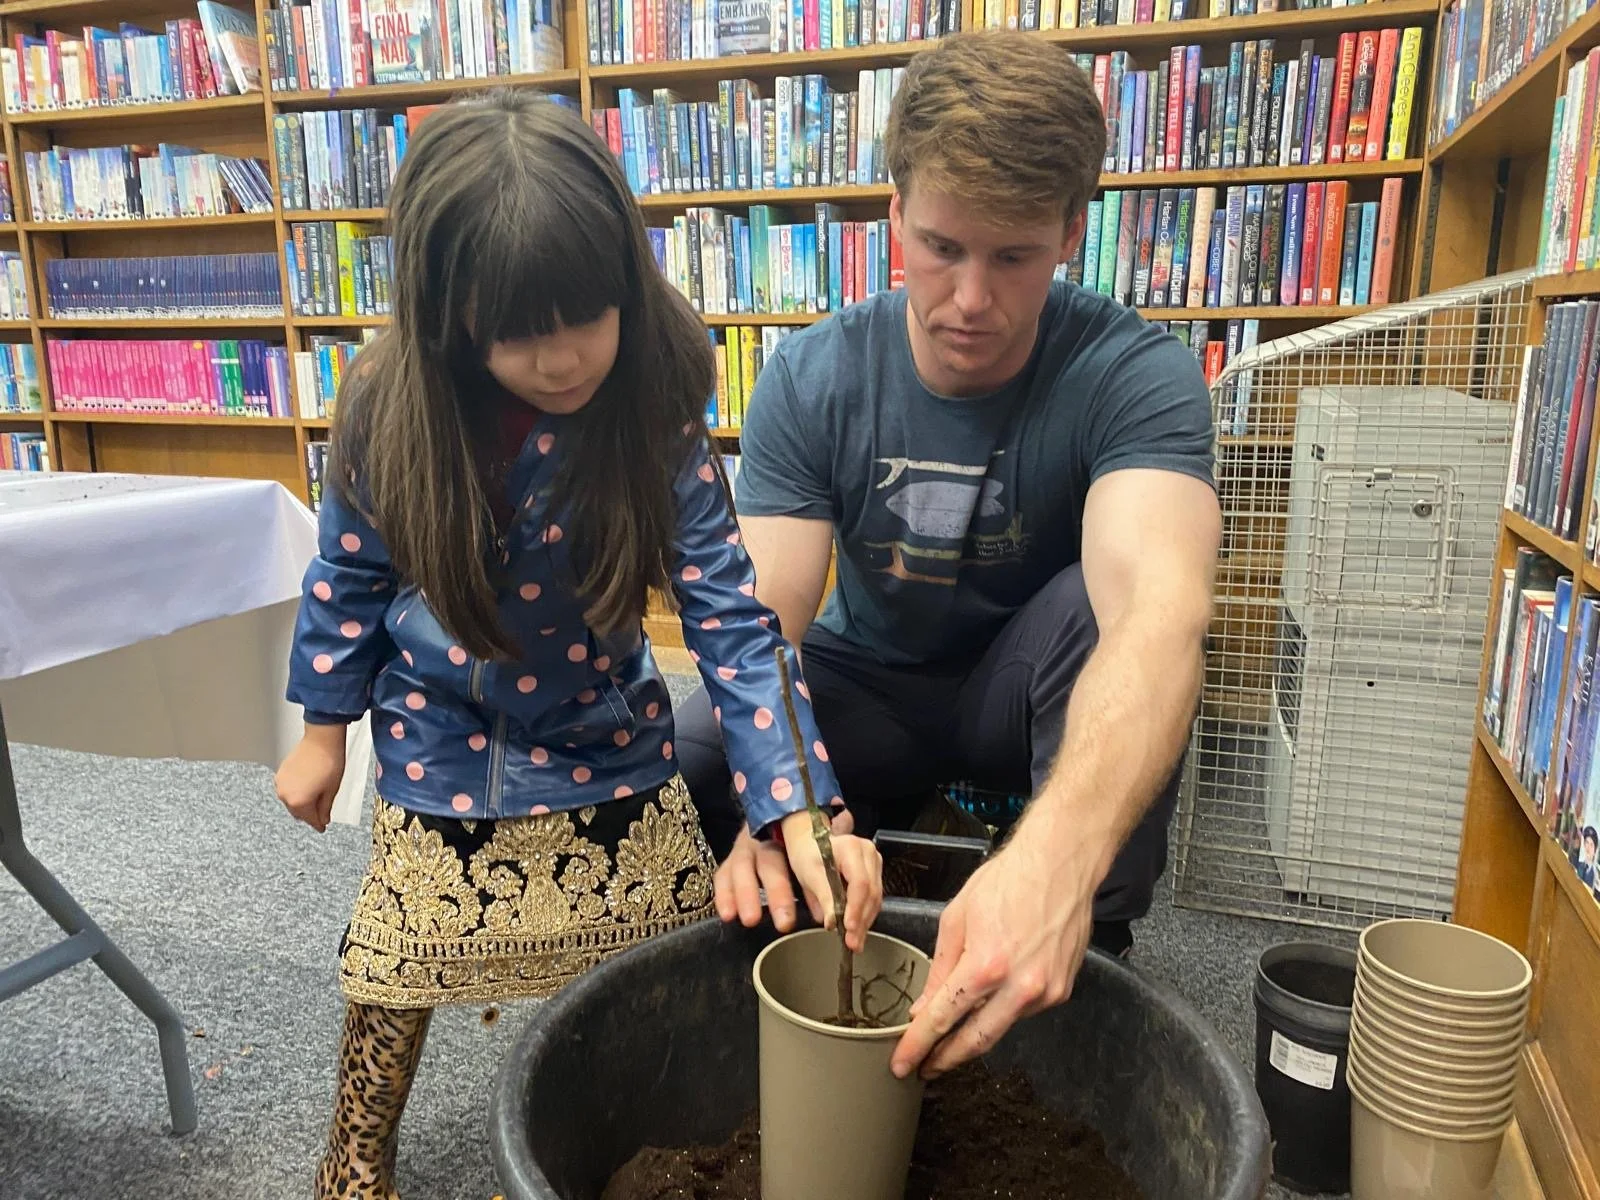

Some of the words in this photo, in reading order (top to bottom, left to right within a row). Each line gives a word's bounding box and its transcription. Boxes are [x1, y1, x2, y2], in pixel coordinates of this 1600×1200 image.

[375, 12, 413, 39] FINAL
[380, 39, 412, 65] NAIL
[1358, 36, 1373, 76] Cleeves
[1406, 33, 1419, 61] Ann
[1172, 51, 1182, 73] THE
[1171, 75, 1181, 97] LIES
[1339, 72, 1350, 99] CLARY
[1396, 62, 1416, 117] Cleeves
[1169, 107, 1179, 130] TELL
[1270, 96, 1281, 128] FOLLOW
[1268, 129, 1278, 140] ME
[1142, 198, 1155, 231] Harlan
[1161, 201, 1172, 230] Harlan
[1179, 199, 1190, 229] Harlan
[1227, 195, 1241, 237] HANGMAN
[1291, 194, 1299, 214] From
[1088, 205, 1099, 247] HARLAN
[1250, 212, 1260, 252] MARTINA
[1270, 211, 1281, 252] MARTINA
[1288, 231, 1296, 247] Until
[1175, 231, 1187, 259] Coben
[1085, 249, 1097, 285] COBEN
[1211, 247, 1221, 275] COBEN
[1248, 254, 1258, 279] COLE
[1267, 254, 1277, 278] COLE
[1135, 270, 1148, 292] WIN
[1171, 263, 1183, 290] MATCH
